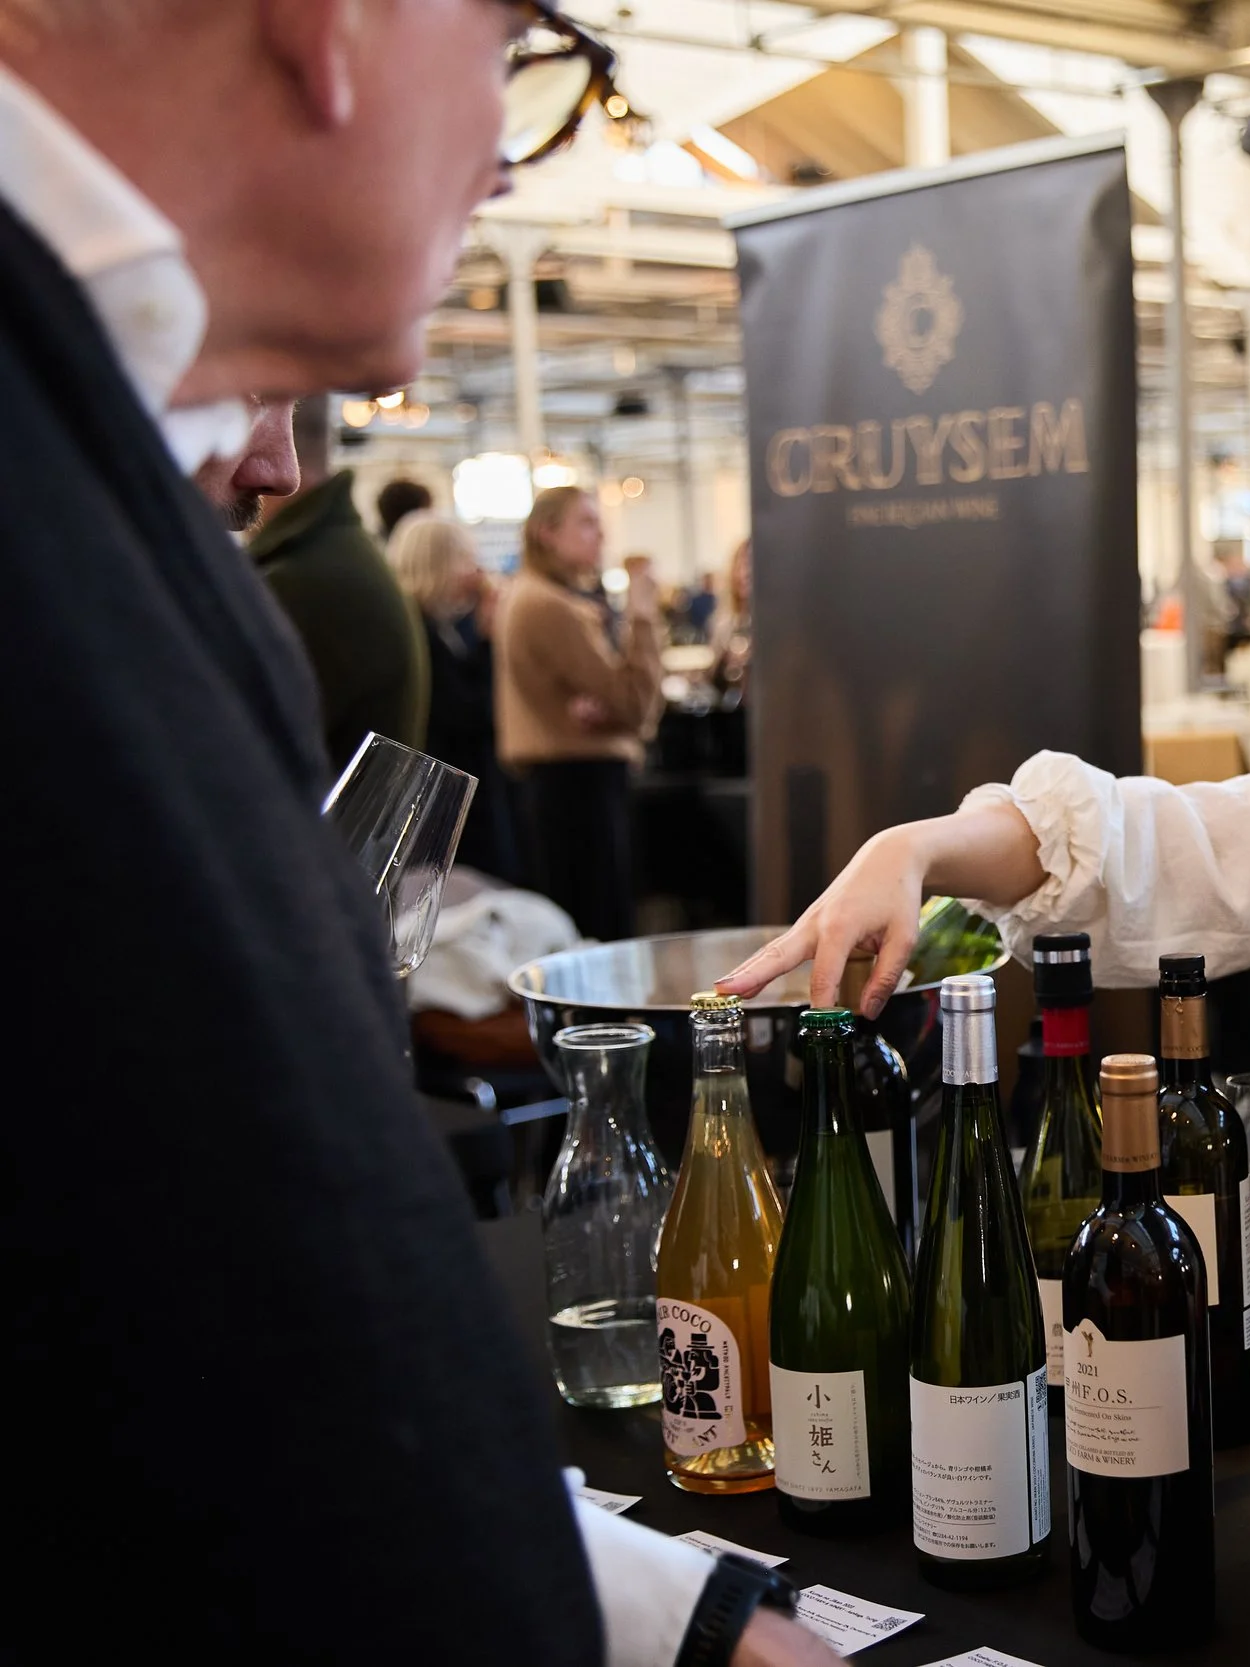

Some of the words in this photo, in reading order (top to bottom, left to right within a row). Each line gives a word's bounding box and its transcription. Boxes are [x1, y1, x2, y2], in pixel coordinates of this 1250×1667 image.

[766, 398, 1090, 497] CRUYSEM
[672, 1305, 712, 1333] COCO
[1077, 1362, 1099, 1377] 2021
[806, 1384, 837, 1474] 小姫さん
[1077, 1450, 1094, 1462] FARM
[1102, 1455, 1137, 1466] WINERY
[825, 1484, 862, 1493] YAMAGATA
